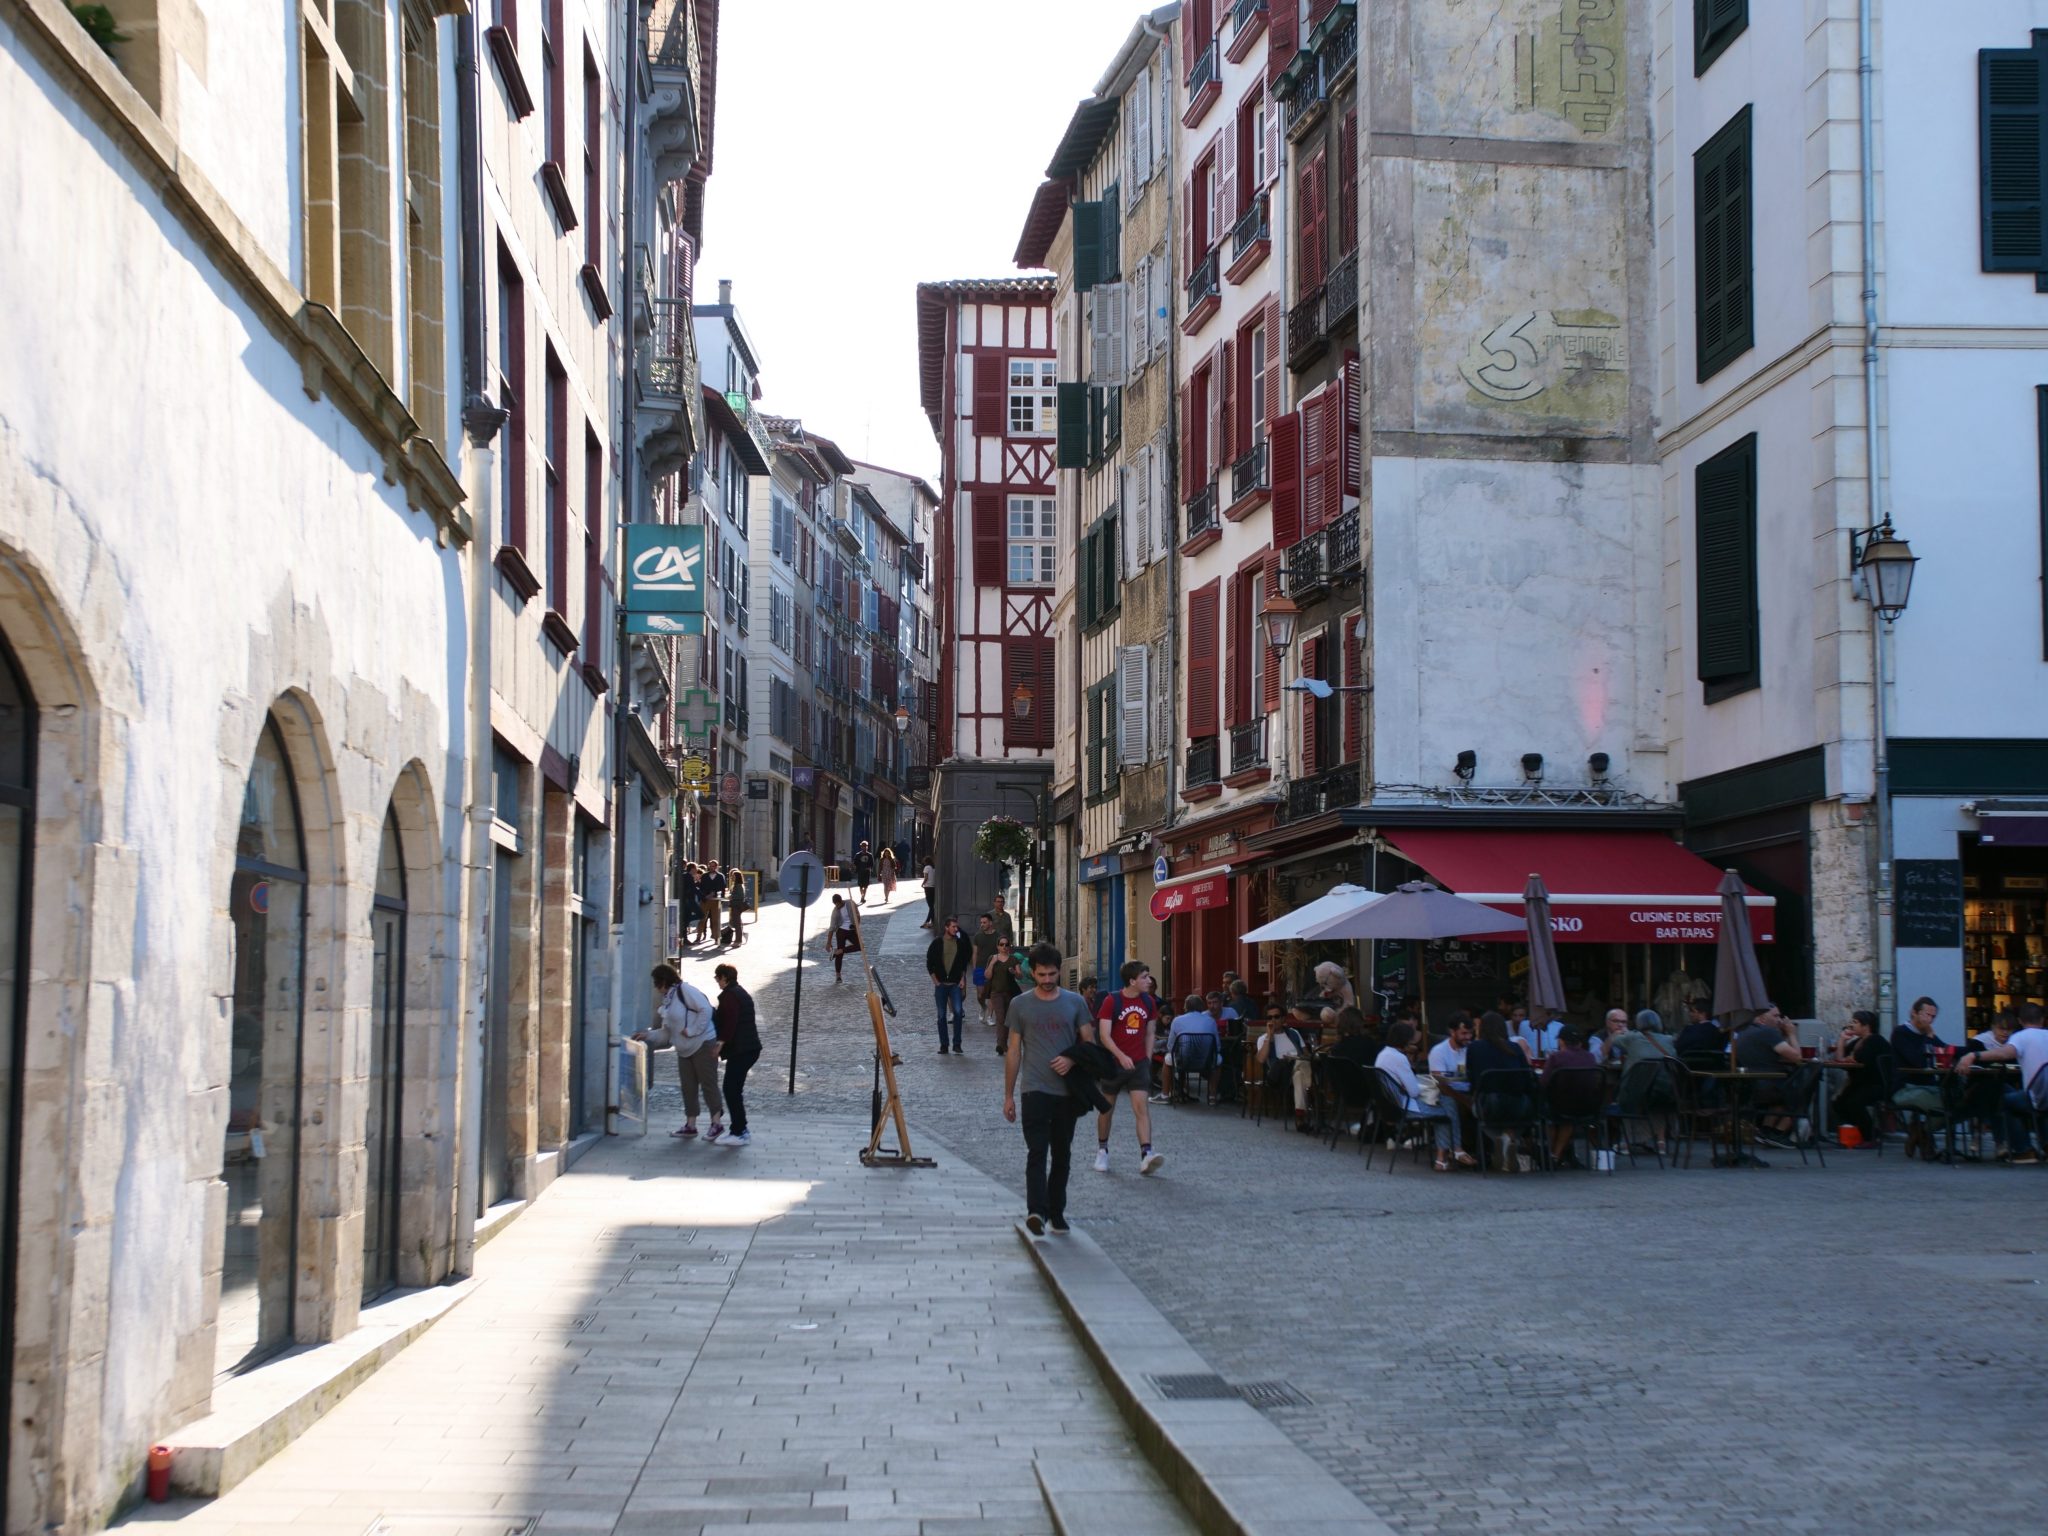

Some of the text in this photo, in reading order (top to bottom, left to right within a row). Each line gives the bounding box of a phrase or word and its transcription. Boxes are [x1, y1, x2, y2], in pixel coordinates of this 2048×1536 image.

[1630, 911, 1674, 923] CUISINE
[1676, 912, 1691, 923] DE
[1656, 927, 1714, 939] BAR TAPAS
